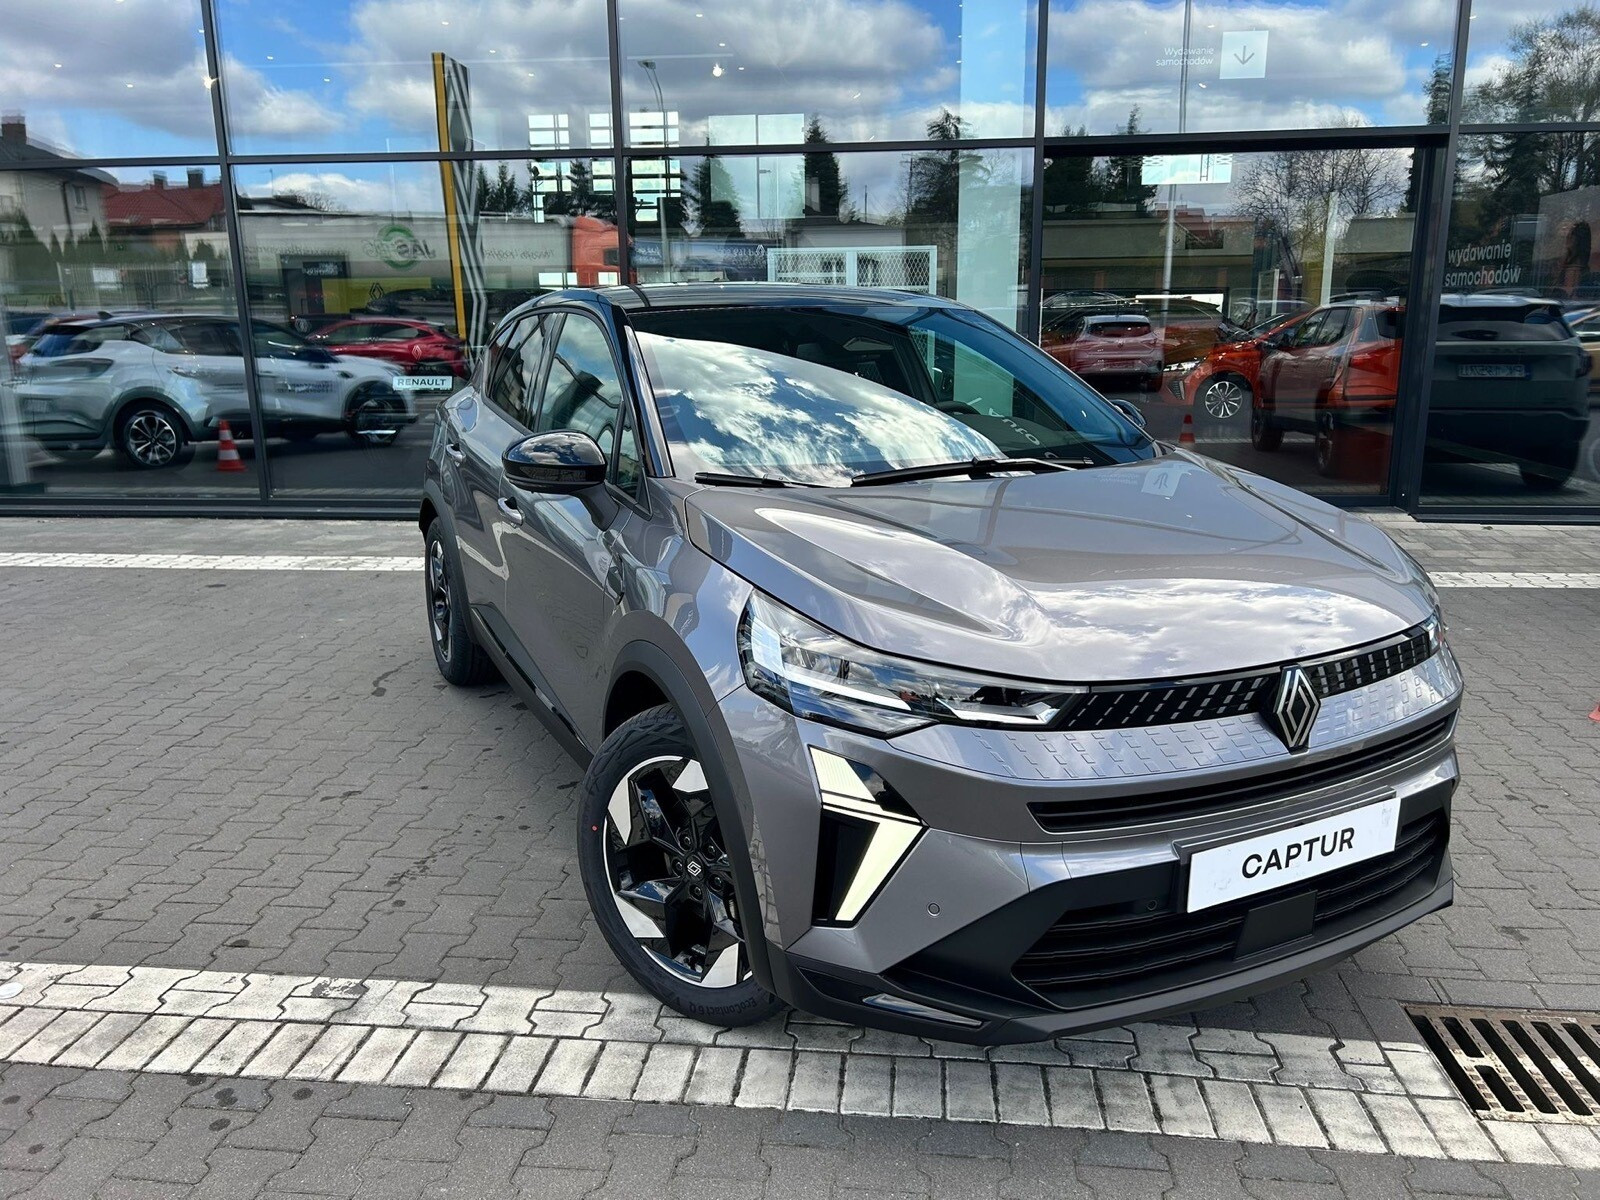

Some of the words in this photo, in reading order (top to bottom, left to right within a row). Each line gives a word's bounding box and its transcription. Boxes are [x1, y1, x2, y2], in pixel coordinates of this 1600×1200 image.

[1164, 47, 1214, 57] Wydawanie
[1156, 57, 1213, 67] samochodów
[1448, 239, 1512, 267] wydawanie
[1444, 264, 1522, 287] samochodów
[397, 378, 447, 386] RENAULT
[1241, 827, 1355, 879] CAPTUR
